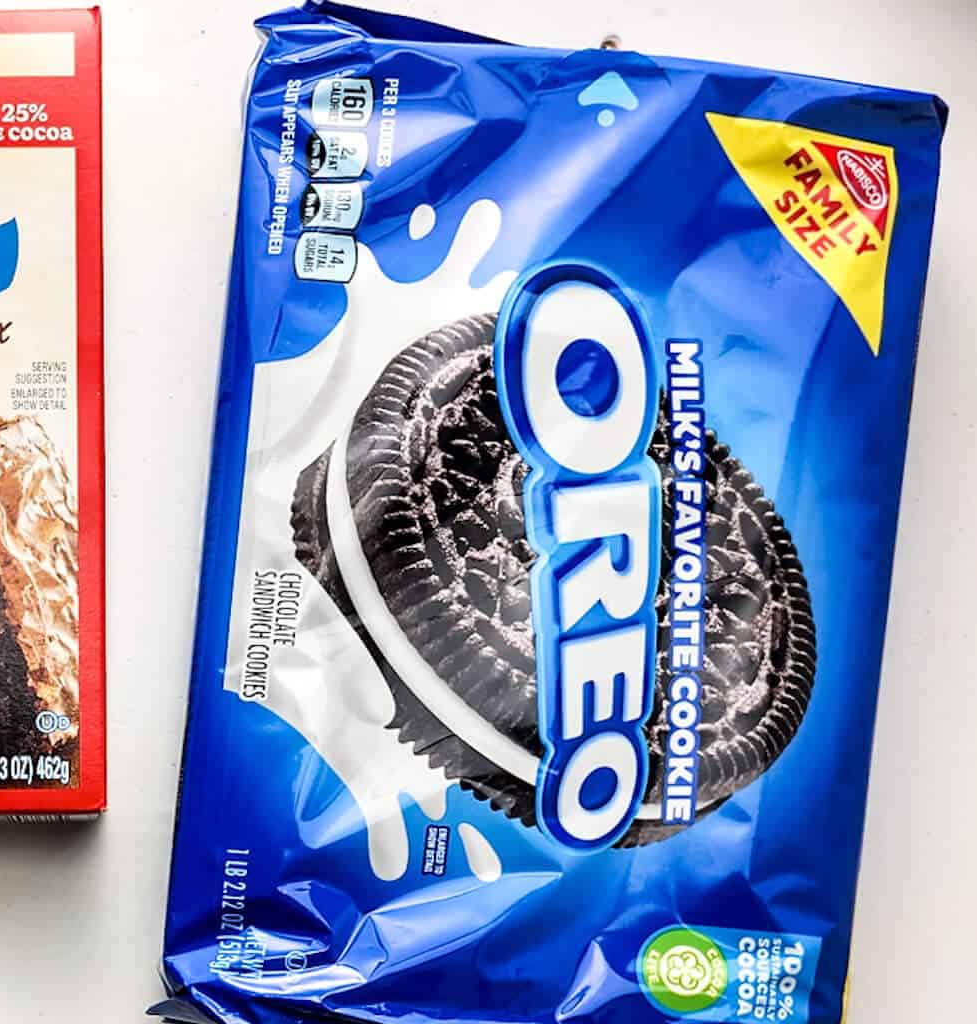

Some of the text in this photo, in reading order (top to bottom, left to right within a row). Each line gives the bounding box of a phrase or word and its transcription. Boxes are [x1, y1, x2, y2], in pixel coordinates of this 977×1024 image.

[1, 103, 48, 122] 25%
[342, 87, 366, 121] 160
[382, 77, 399, 105] PER
[8, 126, 74, 142] cocoa
[278, 107, 298, 164] APPEARS
[327, 154, 339, 171] FAT
[841, 154, 882, 205] NABISCO
[273, 166, 293, 203] WHEN
[784, 147, 878, 256] FAMILY
[268, 206, 288, 255] OPENED
[774, 189, 836, 259] SIZE
[302, 238, 317, 273] SUGARS
[316, 244, 329, 270] TOTAL
[15, 373, 67, 384] SUGGESTION
[518, 274, 654, 847] OREO
[665, 341, 703, 824] MILK'S FAVORITE COOKIE
[273, 572, 302, 647] CHOCOLATE
[242, 571, 277, 698] SANDWICH COOKIES
[11, 755, 34, 785] OZ)
[36, 755, 70, 785] 462g
[224, 861, 248, 877] LB
[221, 881, 246, 910] 2.12
[220, 913, 244, 931] OZ
[644, 950, 661, 986] LIFE
[703, 947, 723, 999] COCOA
[737, 937, 756, 1016] COCOA
[753, 938, 771, 1019] SOURCED
[766, 938, 783, 1022] SUSTAINABLY
[777, 942, 804, 1020] 100%
